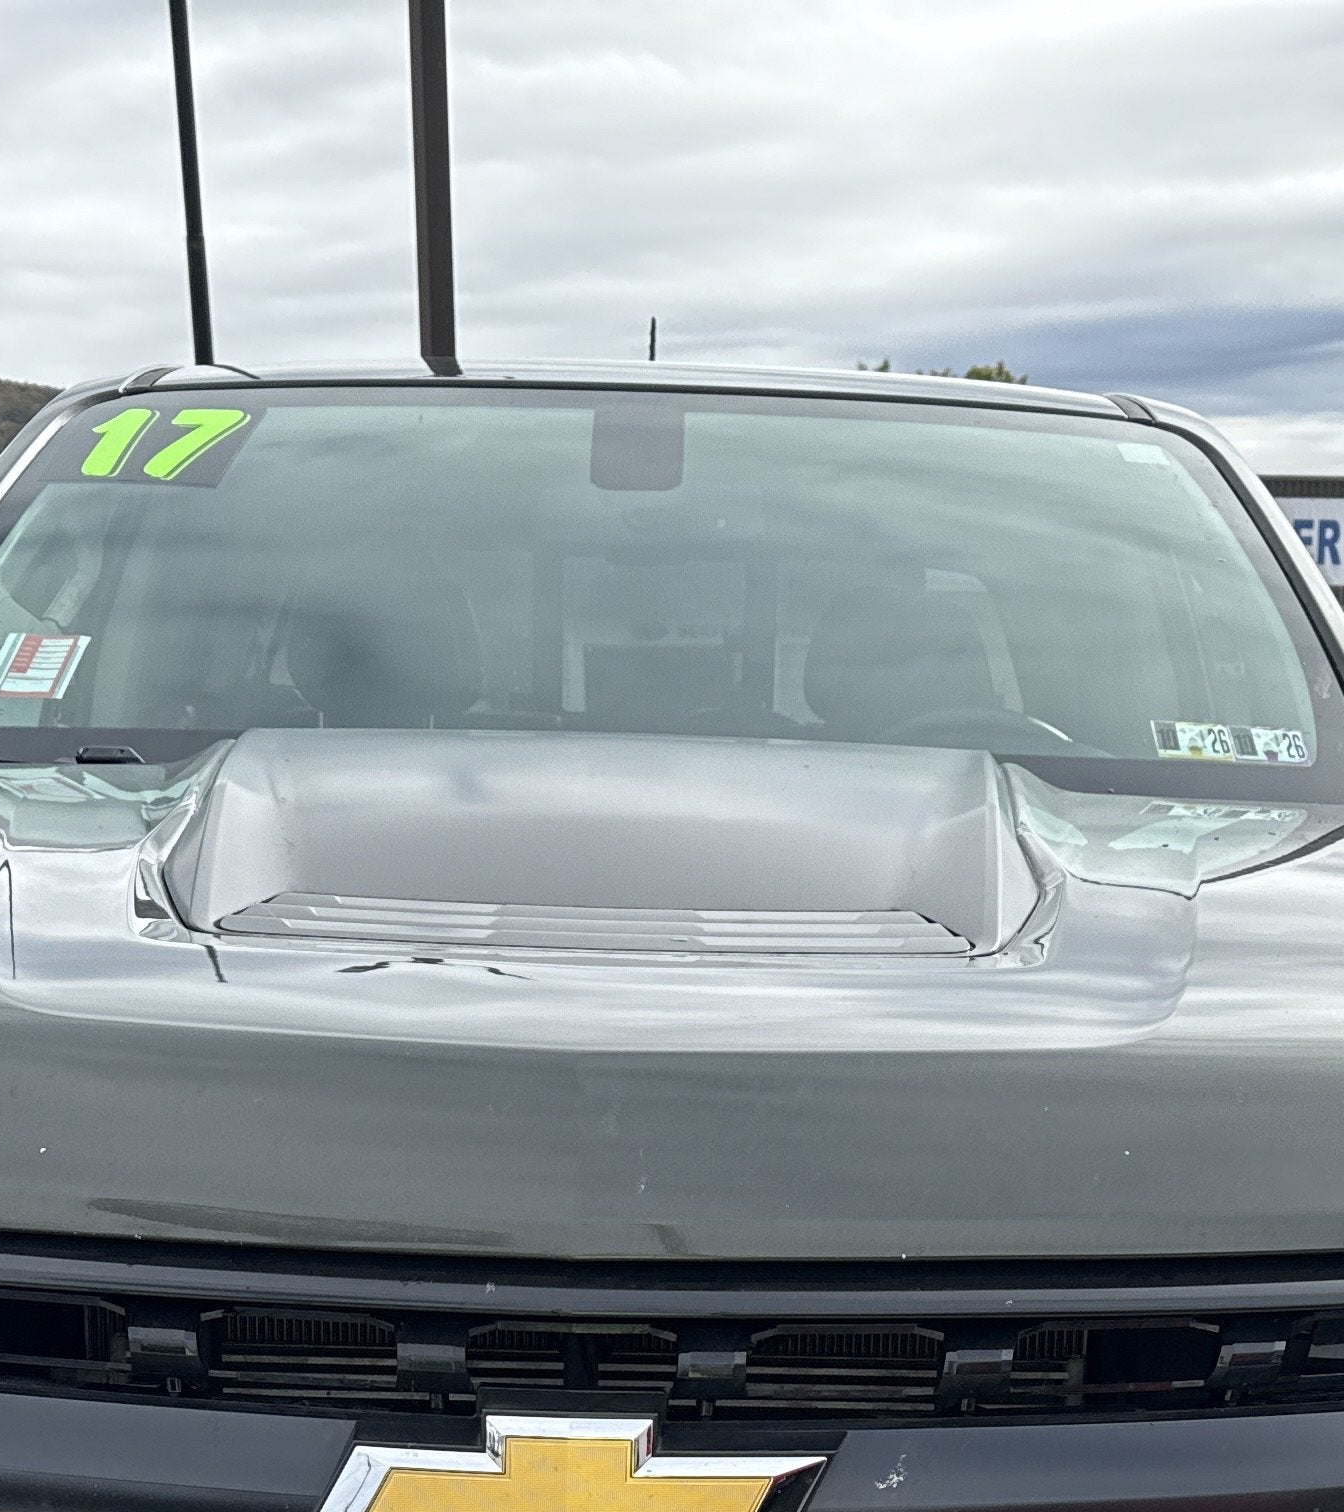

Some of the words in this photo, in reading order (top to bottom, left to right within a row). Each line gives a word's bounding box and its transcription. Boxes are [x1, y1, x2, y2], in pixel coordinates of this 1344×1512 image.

[80, 408, 252, 481] 17
[1208, 728, 1232, 754] 26
[1282, 733, 1307, 759] 26
